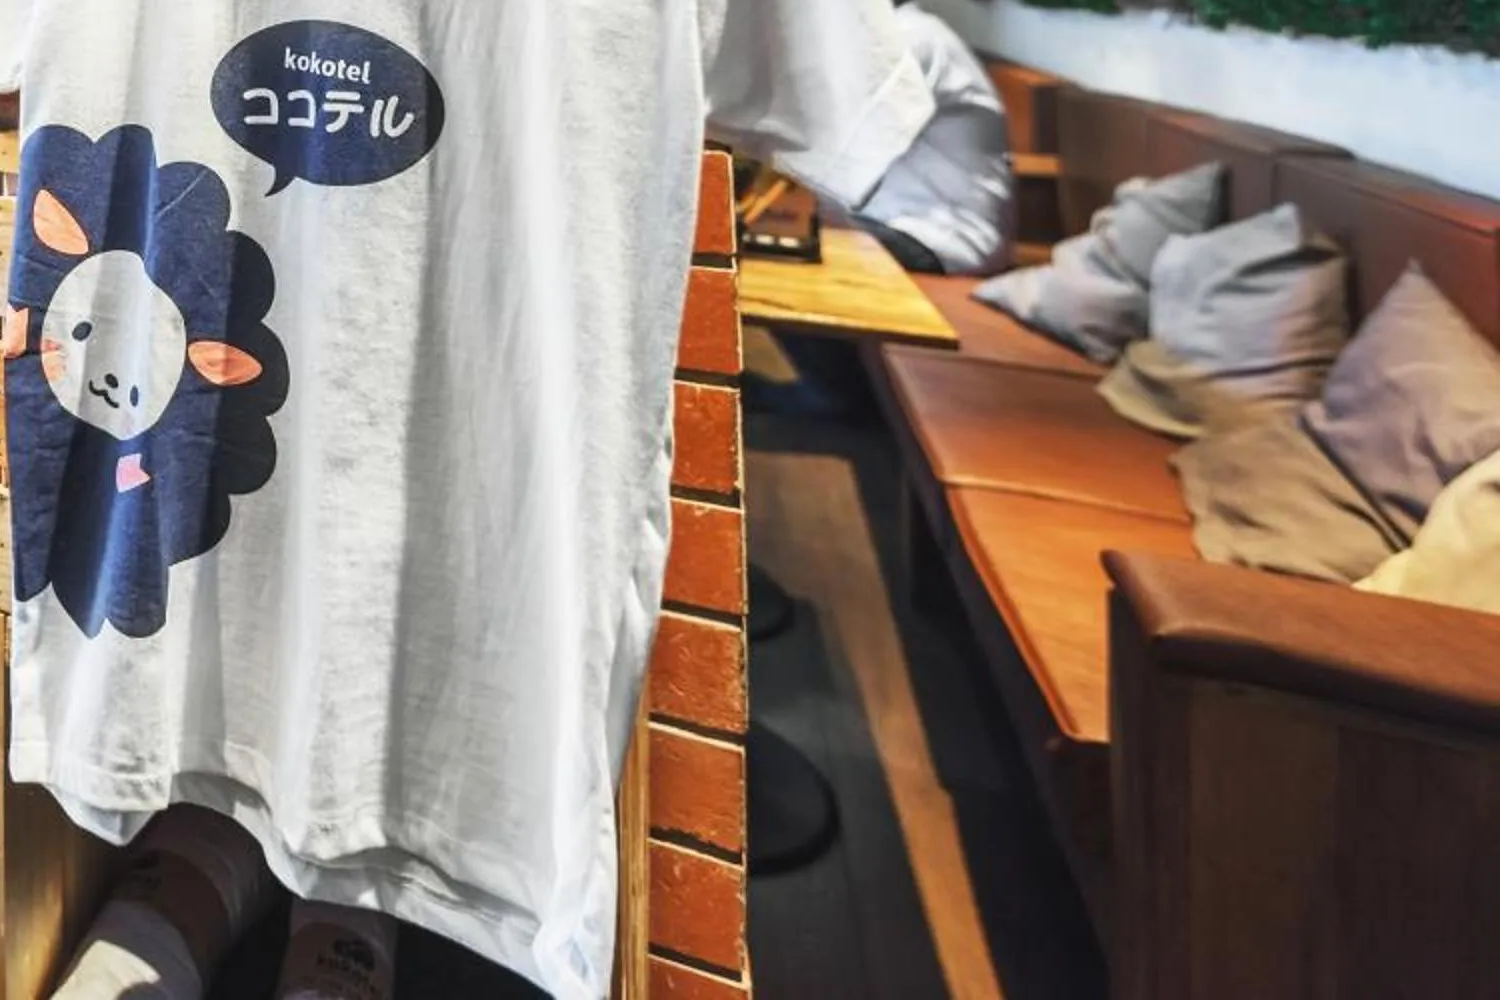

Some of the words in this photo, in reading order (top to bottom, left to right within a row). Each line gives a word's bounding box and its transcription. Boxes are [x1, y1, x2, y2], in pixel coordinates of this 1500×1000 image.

[284, 47, 371, 85] kokotel
[243, 87, 414, 138] ココテル
